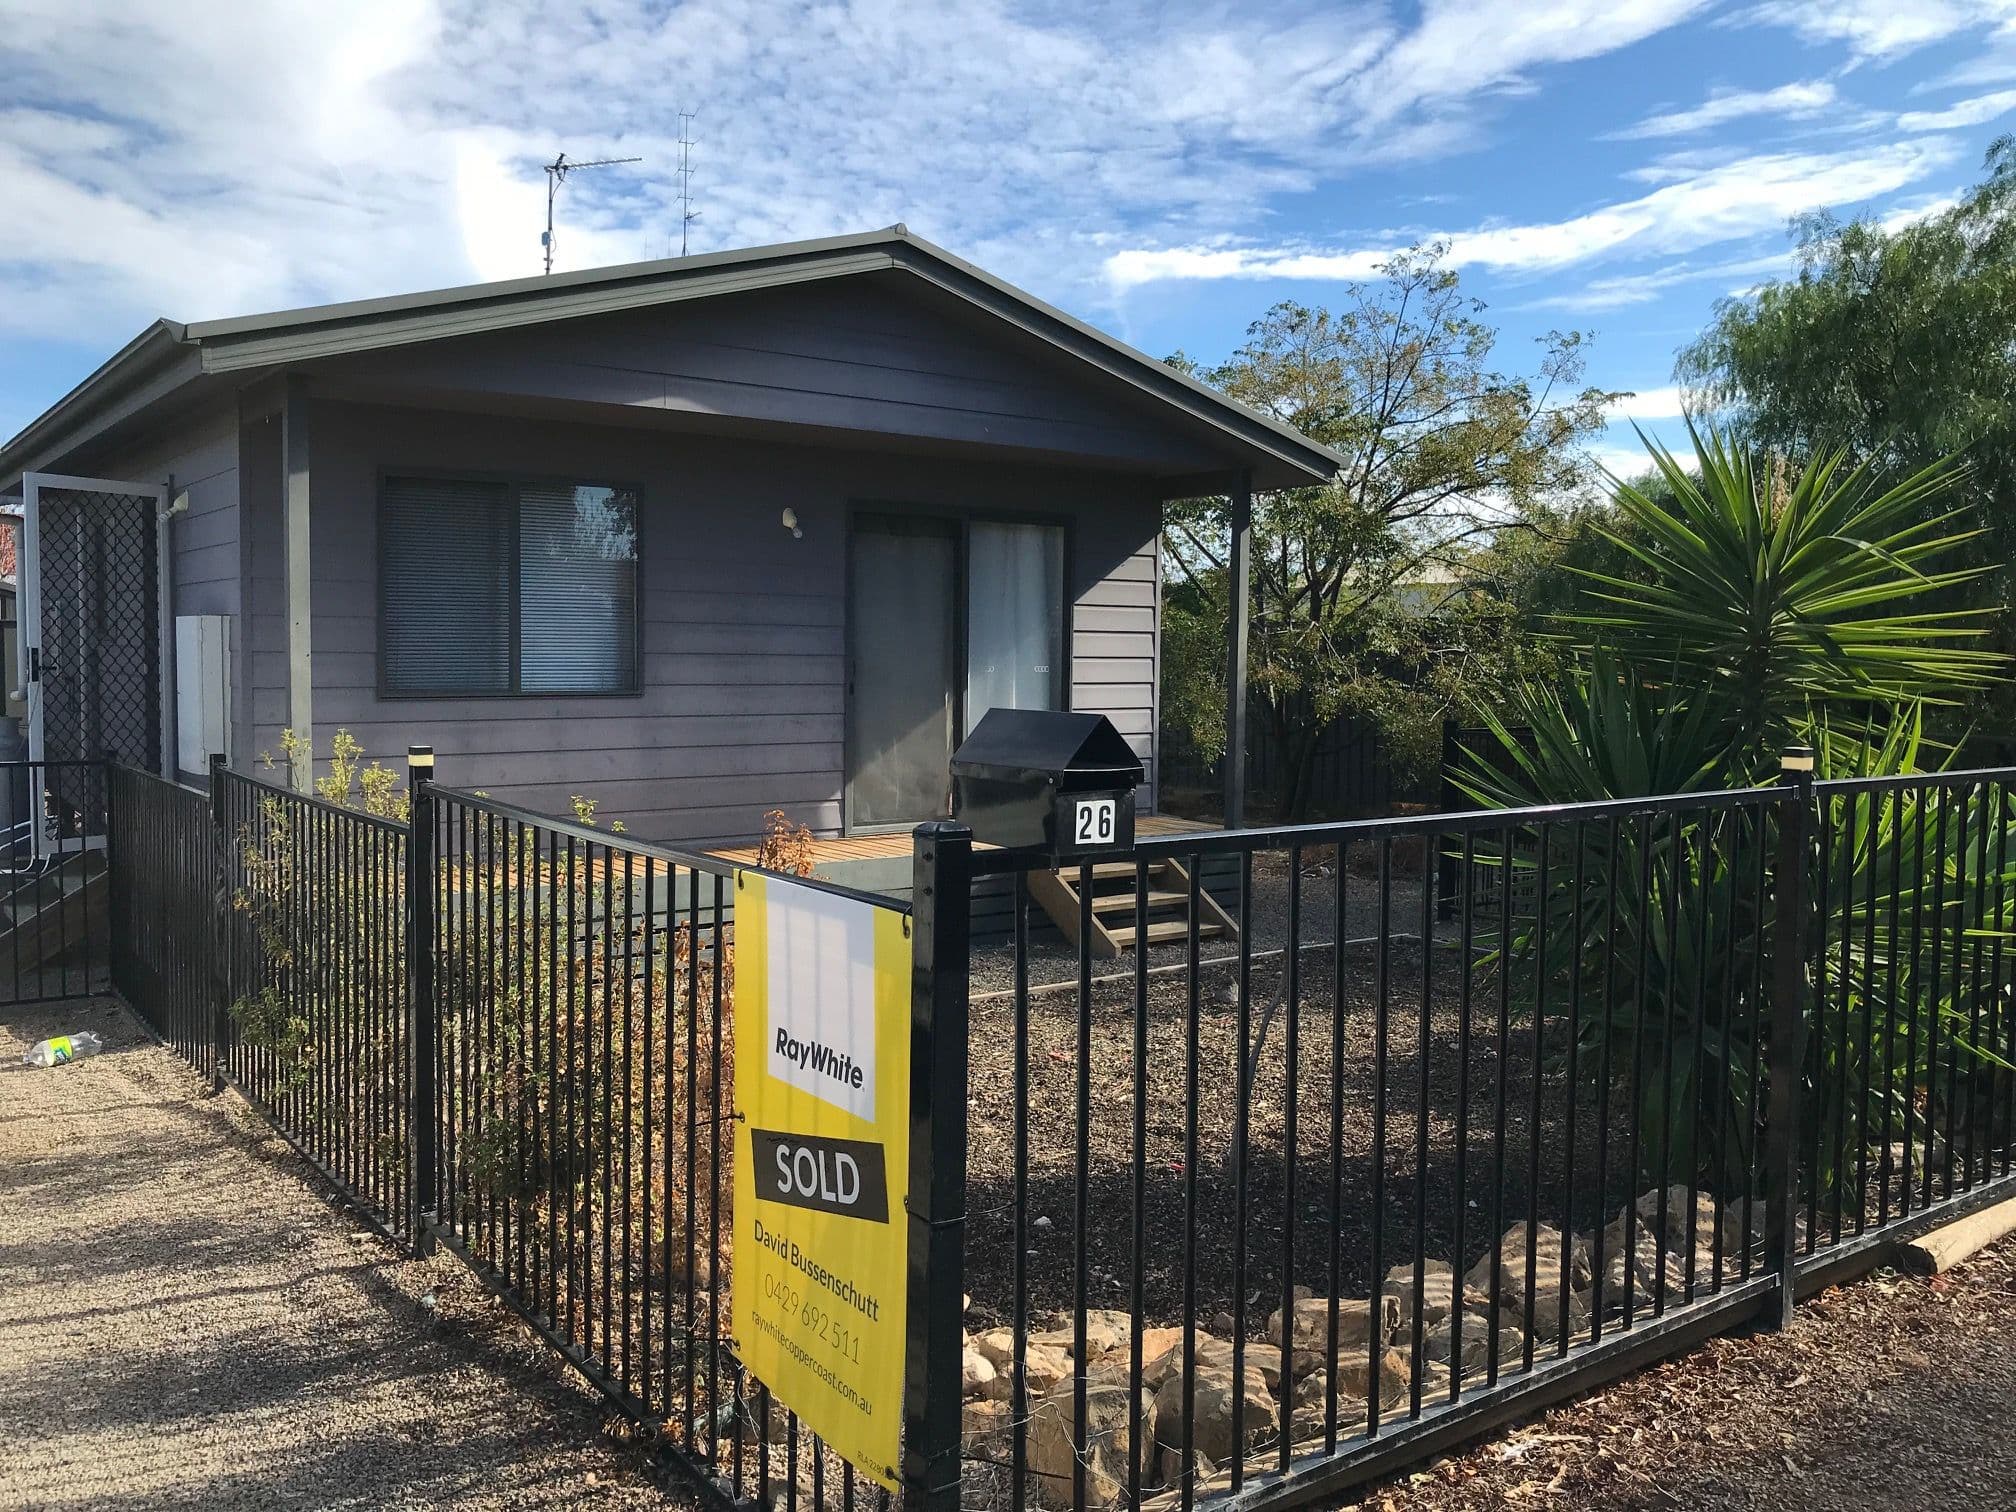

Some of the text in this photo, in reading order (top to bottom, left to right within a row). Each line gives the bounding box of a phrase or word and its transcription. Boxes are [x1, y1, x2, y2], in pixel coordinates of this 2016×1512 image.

[1079, 806, 1111, 840] 26
[776, 1143, 860, 1205] SOLD
[754, 1219, 879, 1322] David Bussenschutt
[752, 1310, 872, 1417] raywhitecoppercoast.com.au
[765, 1273, 860, 1365] 0429 692 511
